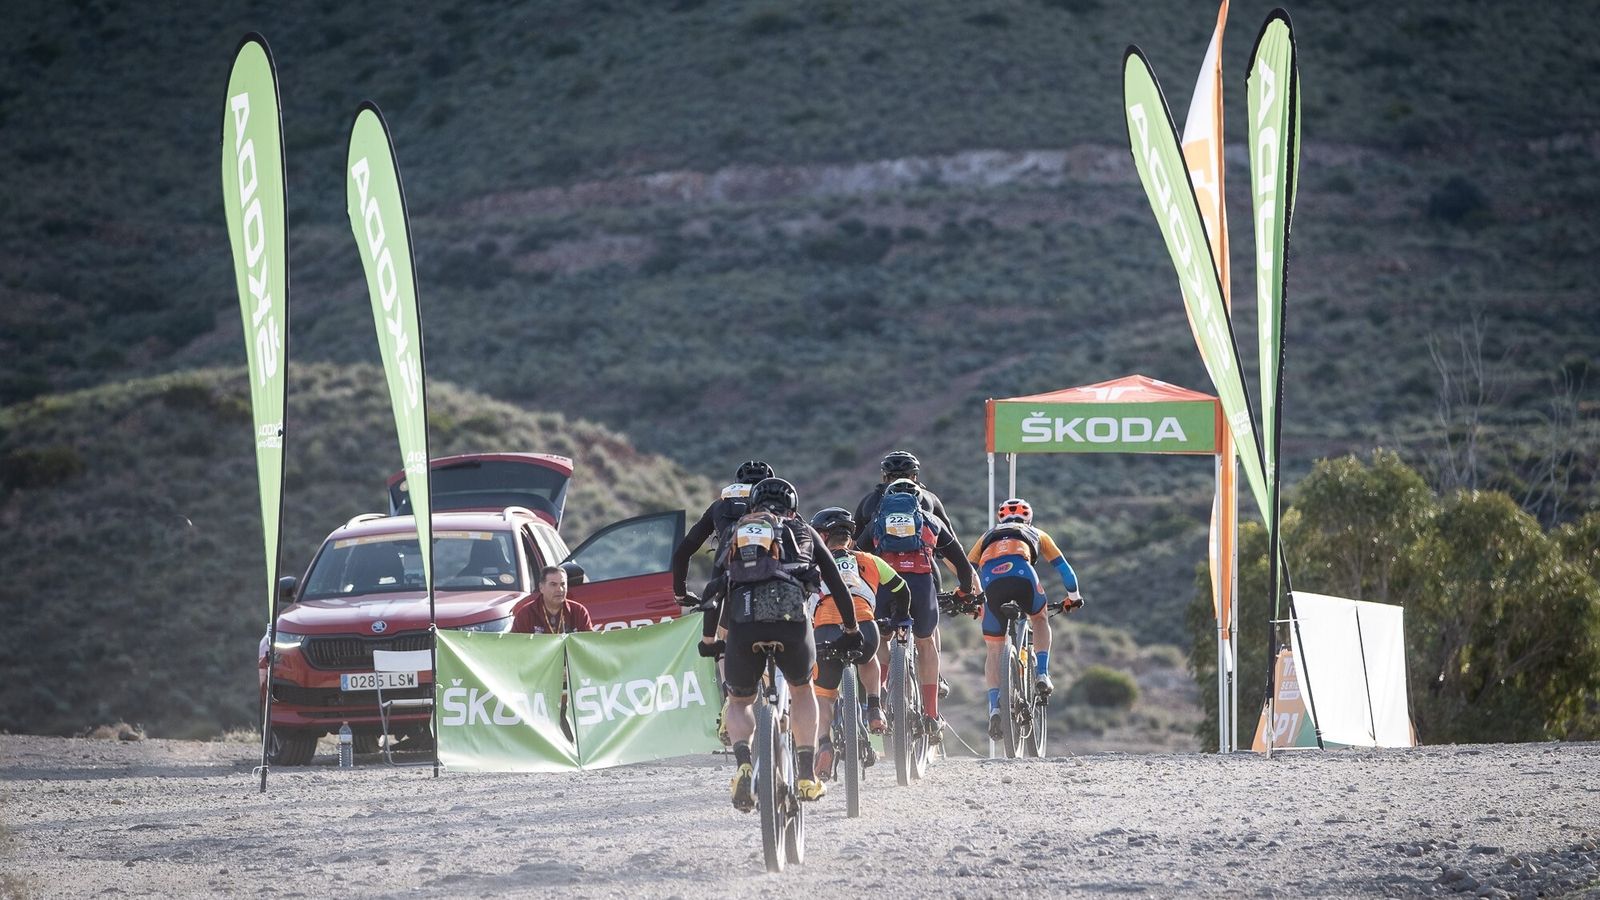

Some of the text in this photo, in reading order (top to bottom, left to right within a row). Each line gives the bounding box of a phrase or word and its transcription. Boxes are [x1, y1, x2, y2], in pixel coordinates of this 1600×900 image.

[1021, 411, 1188, 443] ŠKODA
[889, 516, 911, 524] 222
[746, 526, 763, 535] 32
[350, 673, 415, 689] 0285 LSW
[576, 670, 707, 726] ŠKODA
